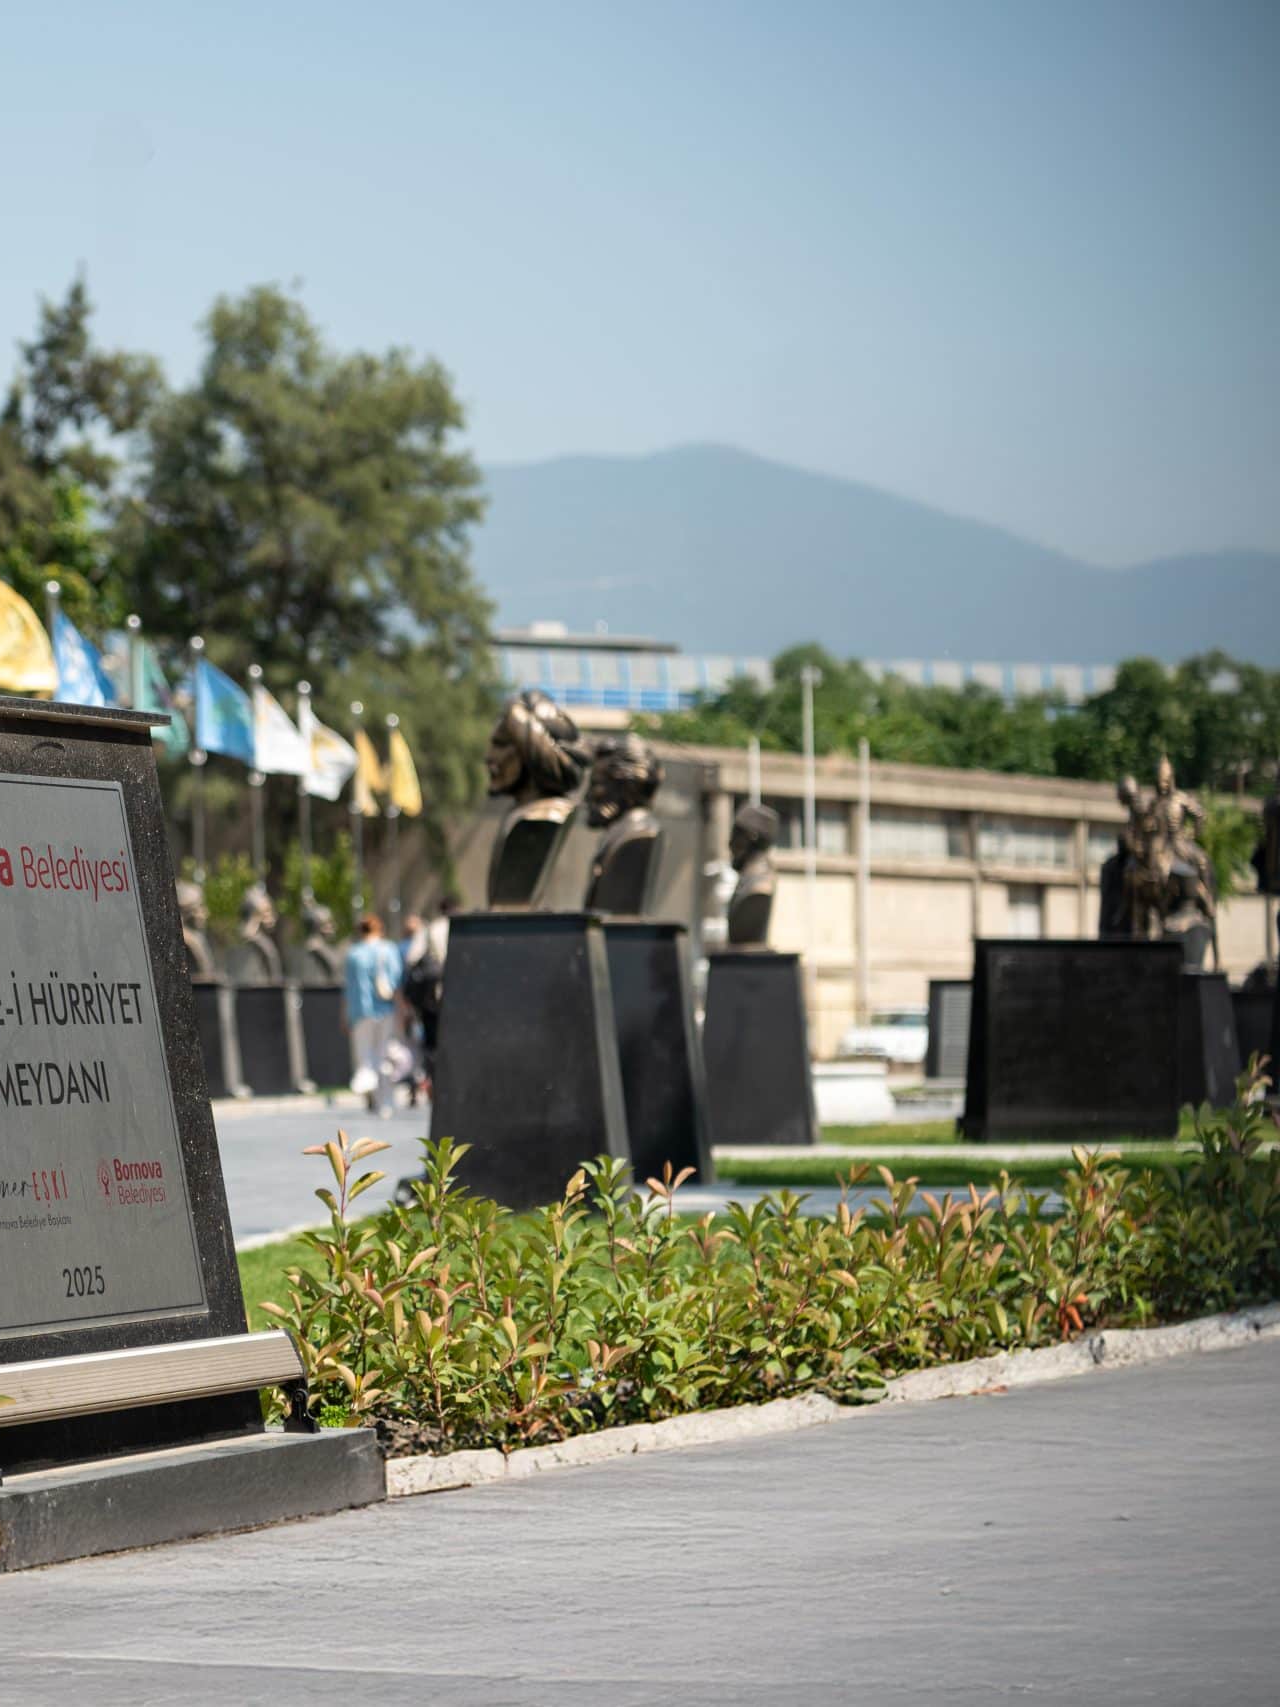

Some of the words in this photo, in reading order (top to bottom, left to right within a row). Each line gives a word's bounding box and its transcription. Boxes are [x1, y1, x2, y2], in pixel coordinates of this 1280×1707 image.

[20, 844, 130, 902] Belediyesi
[28, 970, 143, 1025] HÜRRİYET
[31, 1162, 69, 1208] EŞKİ
[113, 1158, 163, 1181] Bornova
[117, 1183, 167, 1208] Belediyesi
[62, 1265, 105, 1298] 2025
